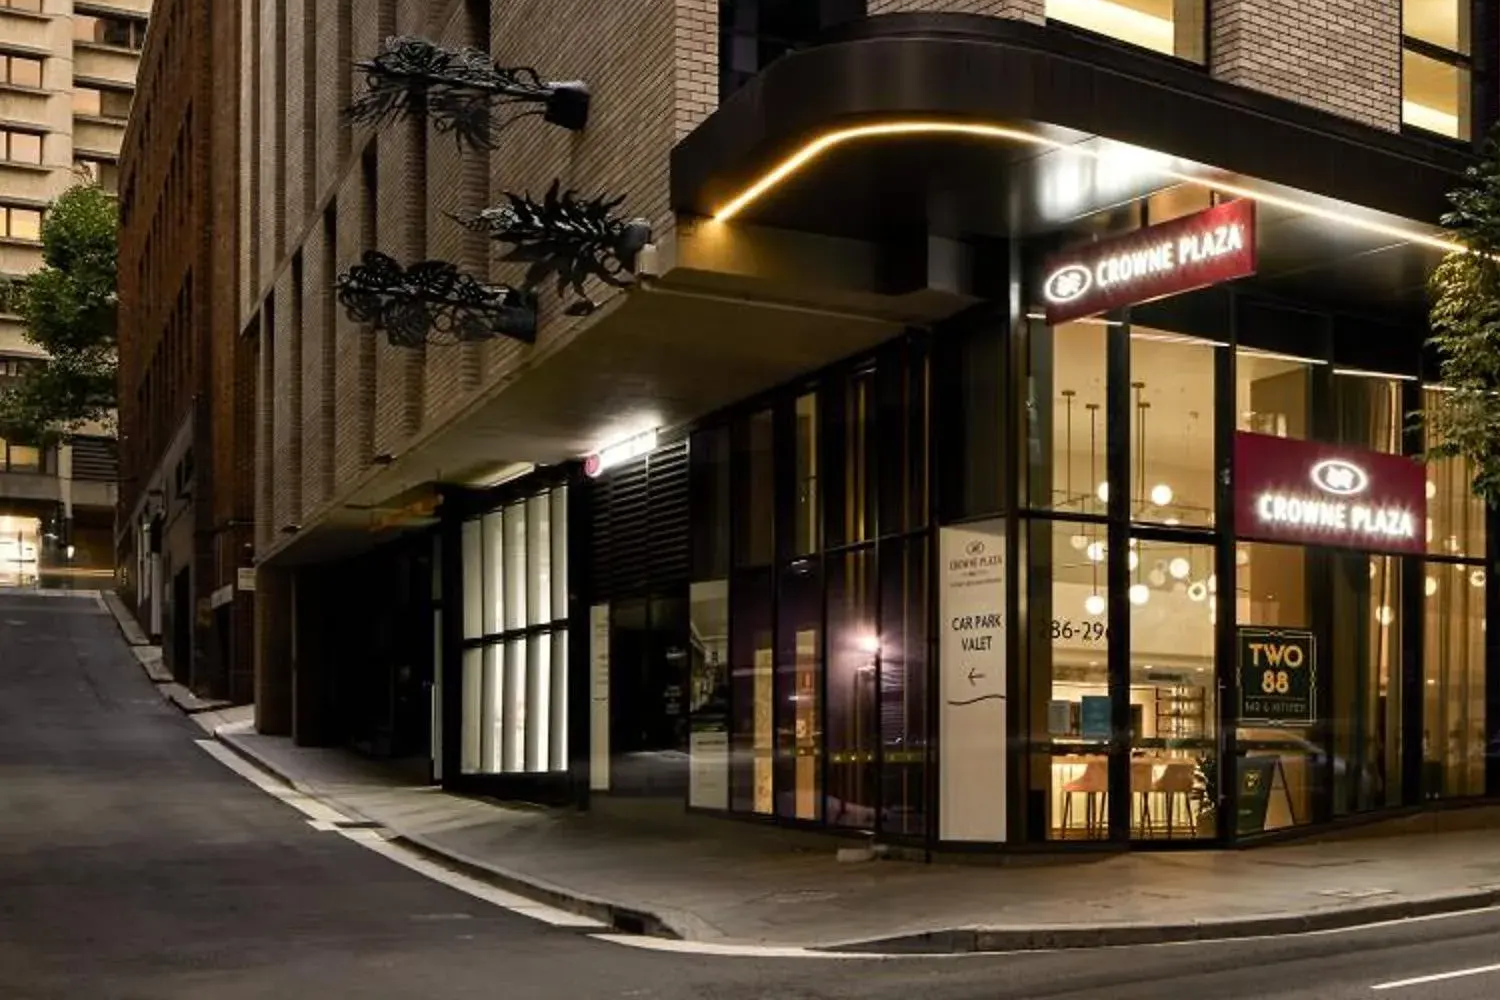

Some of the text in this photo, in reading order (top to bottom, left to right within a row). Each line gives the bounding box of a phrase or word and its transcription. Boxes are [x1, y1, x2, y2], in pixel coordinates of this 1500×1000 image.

[1097, 223, 1242, 287] CROWNE PLAZA
[1258, 493, 1413, 537] CROWNE PLAZA
[952, 613, 1002, 631] CAR PARK
[1047, 619, 1109, 641] 86-29
[961, 635, 992, 651] VALET
[1248, 643, 1303, 667] TWO
[1262, 670, 1289, 693] 88
